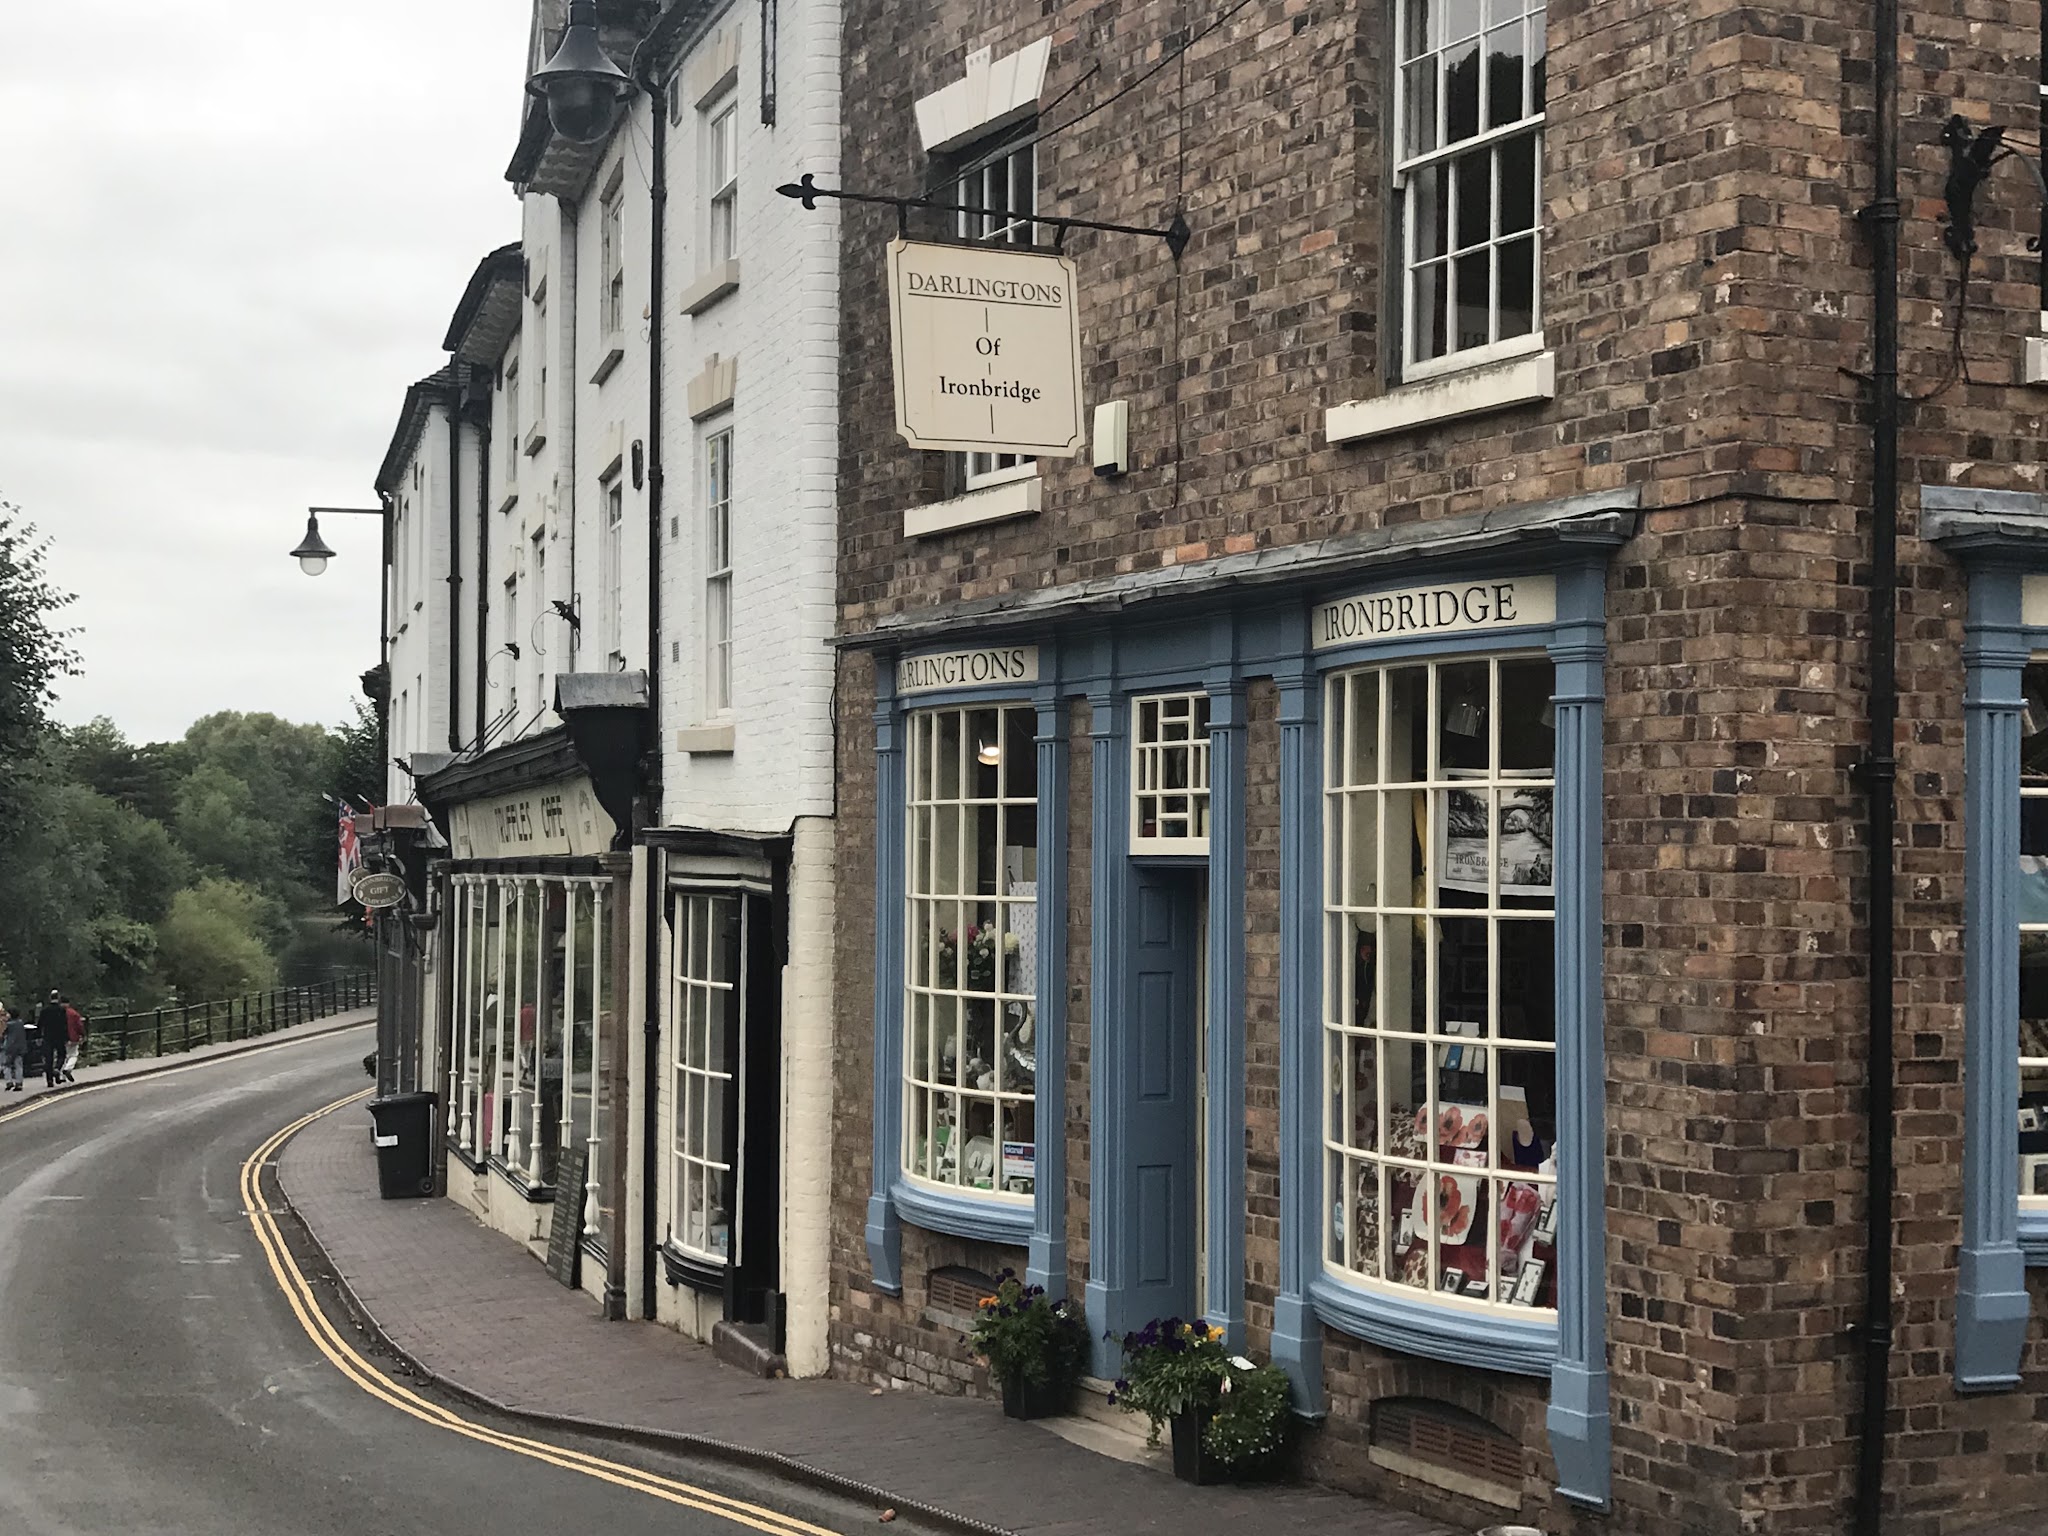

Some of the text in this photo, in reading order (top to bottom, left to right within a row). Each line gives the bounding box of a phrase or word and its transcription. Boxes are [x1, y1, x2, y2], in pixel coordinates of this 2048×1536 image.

[907, 272, 1062, 303] DARLINGTONS
[975, 336, 1001, 356] Of
[939, 375, 1041, 403] Ironbridge
[1323, 583, 1518, 641] IRONBRIDGE
[370, 886, 389, 895] GIFT
